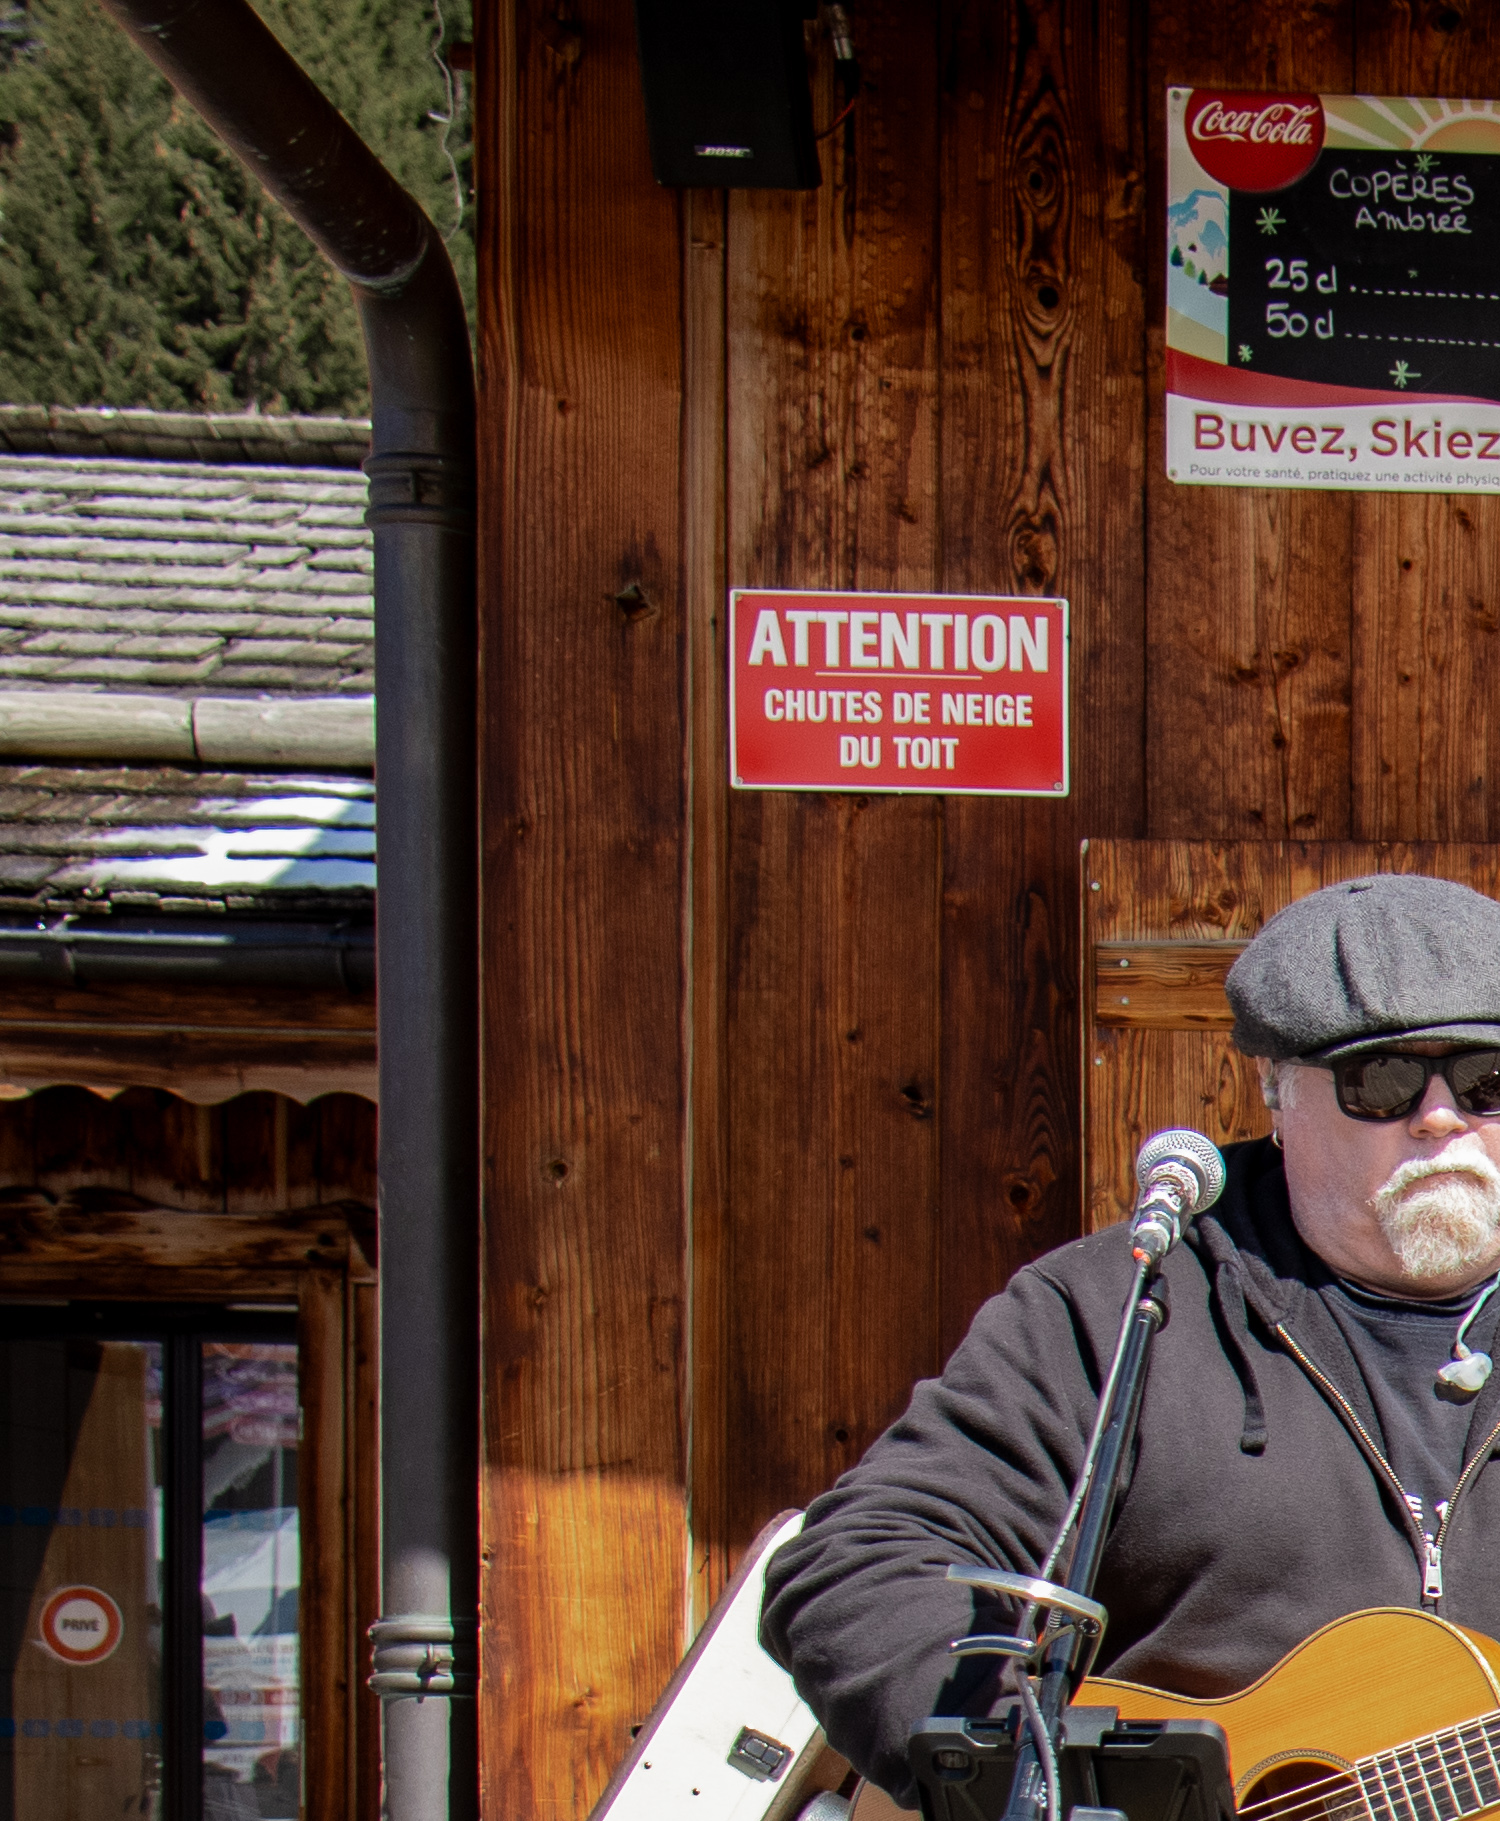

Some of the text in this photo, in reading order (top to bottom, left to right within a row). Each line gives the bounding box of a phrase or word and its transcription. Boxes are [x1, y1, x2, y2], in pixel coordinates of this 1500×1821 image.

[1192, 100, 1320, 145] Coca-Cola
[1193, 412, 1359, 463] Buvez,
[1190, 464, 1221, 477] Pour
[1226, 466, 1260, 478] votre
[1308, 469, 1371, 484] pratiquez
[1376, 473, 1399, 482] une
[1404, 471, 1452, 484] activité
[748, 609, 1050, 674] ATTENTION
[764, 689, 1034, 728] CHUTES DE NEIGE
[840, 735, 959, 770] DU TOIT
